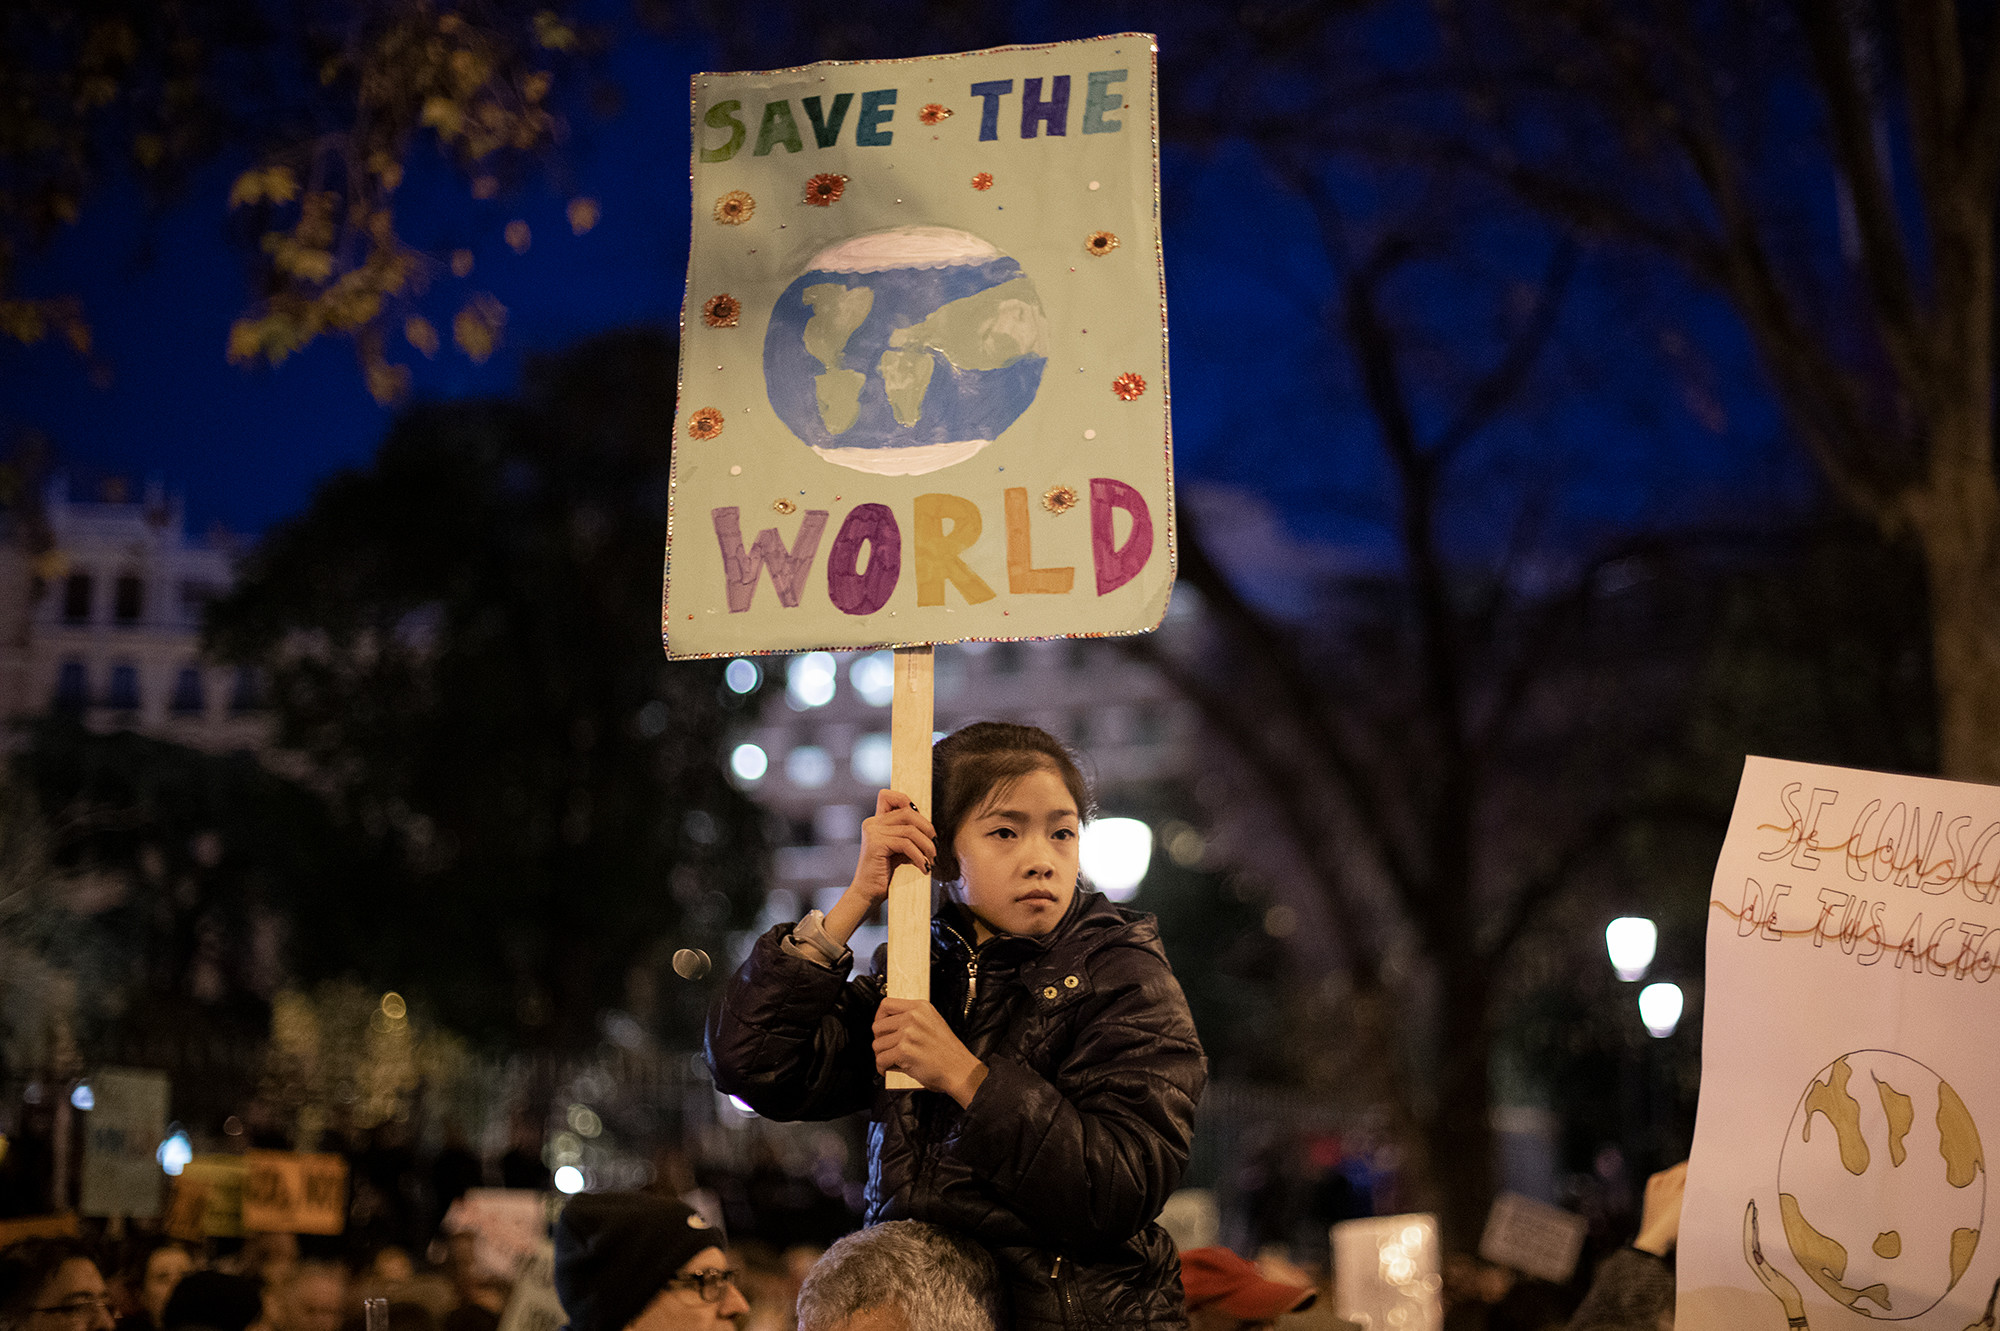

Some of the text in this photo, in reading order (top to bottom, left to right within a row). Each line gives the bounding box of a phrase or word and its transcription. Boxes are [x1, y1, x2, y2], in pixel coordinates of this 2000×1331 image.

[700, 69, 1128, 164] SAVE THE
[711, 478, 1154, 616] WORLD
[1757, 781, 1839, 872] SE
[1737, 877, 1792, 942] DE
[1813, 887, 1887, 967] TUS
